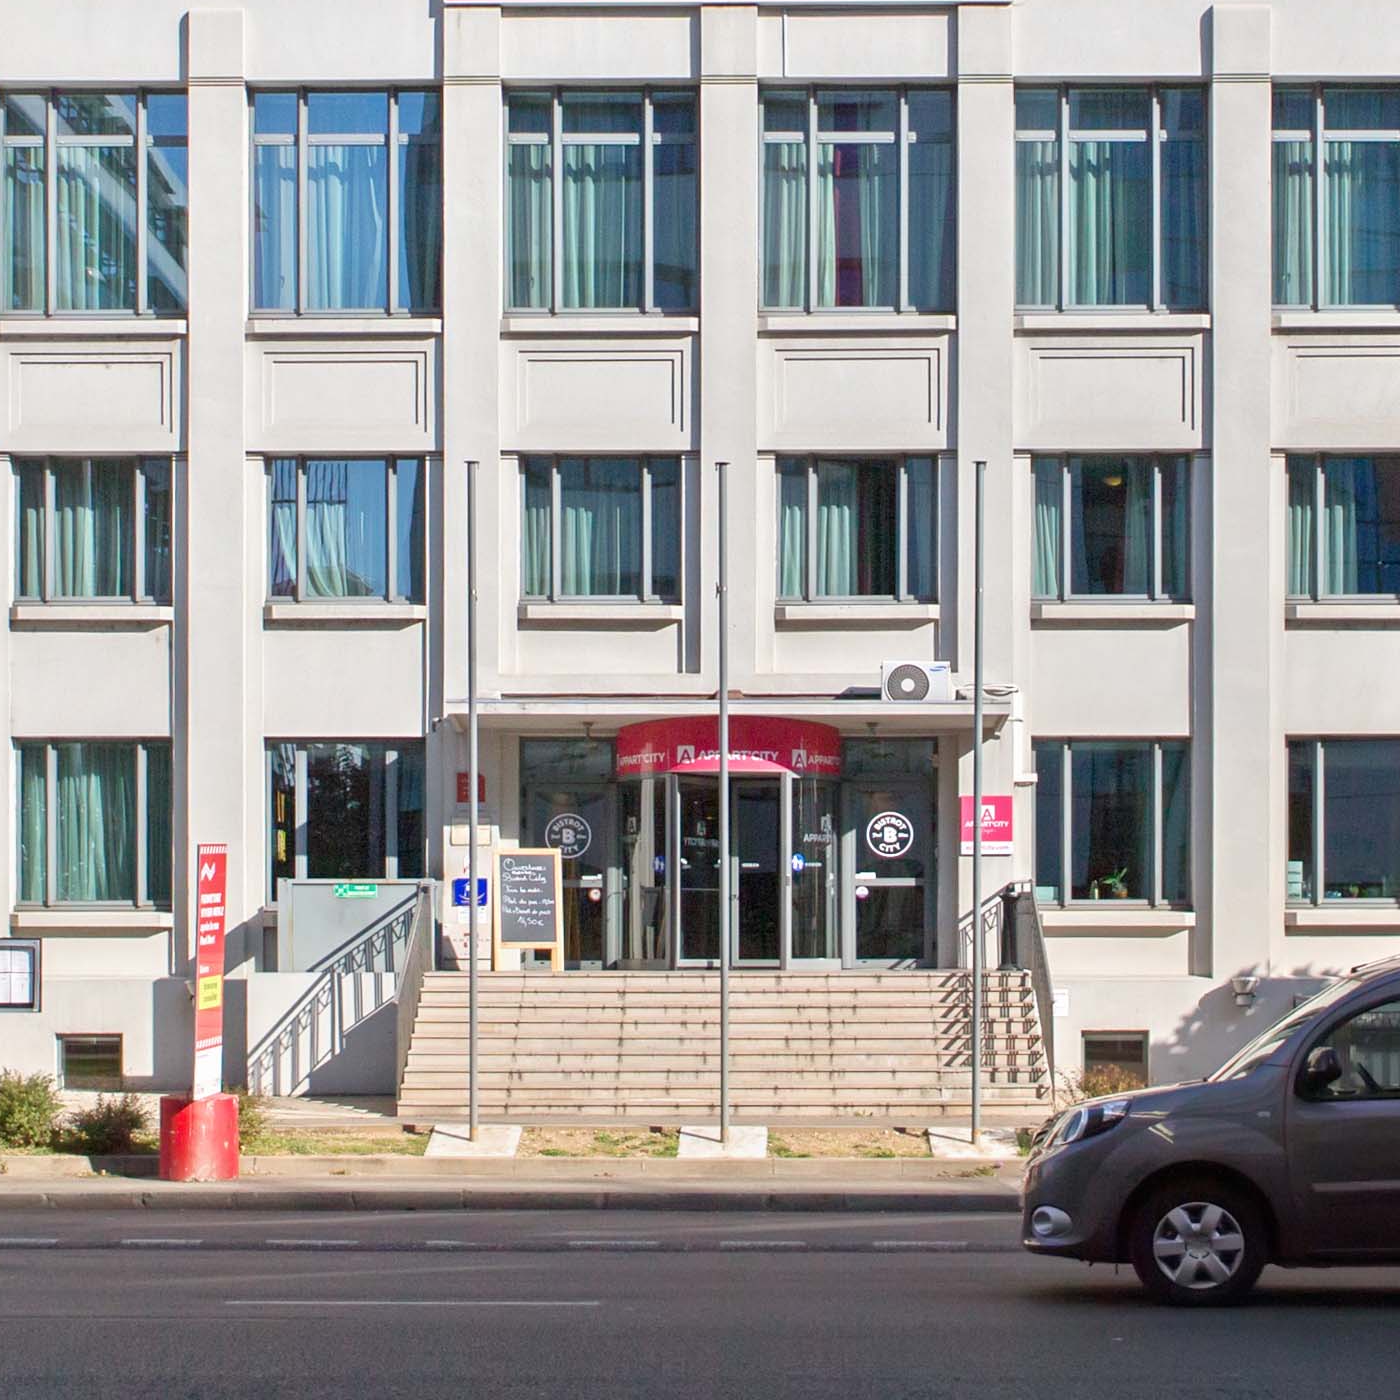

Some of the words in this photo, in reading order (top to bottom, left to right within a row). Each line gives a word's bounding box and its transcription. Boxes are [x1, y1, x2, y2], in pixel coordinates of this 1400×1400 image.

[873, 816, 907, 830] BISTROT
[562, 828, 576, 844] B
[883, 826, 898, 843] B
